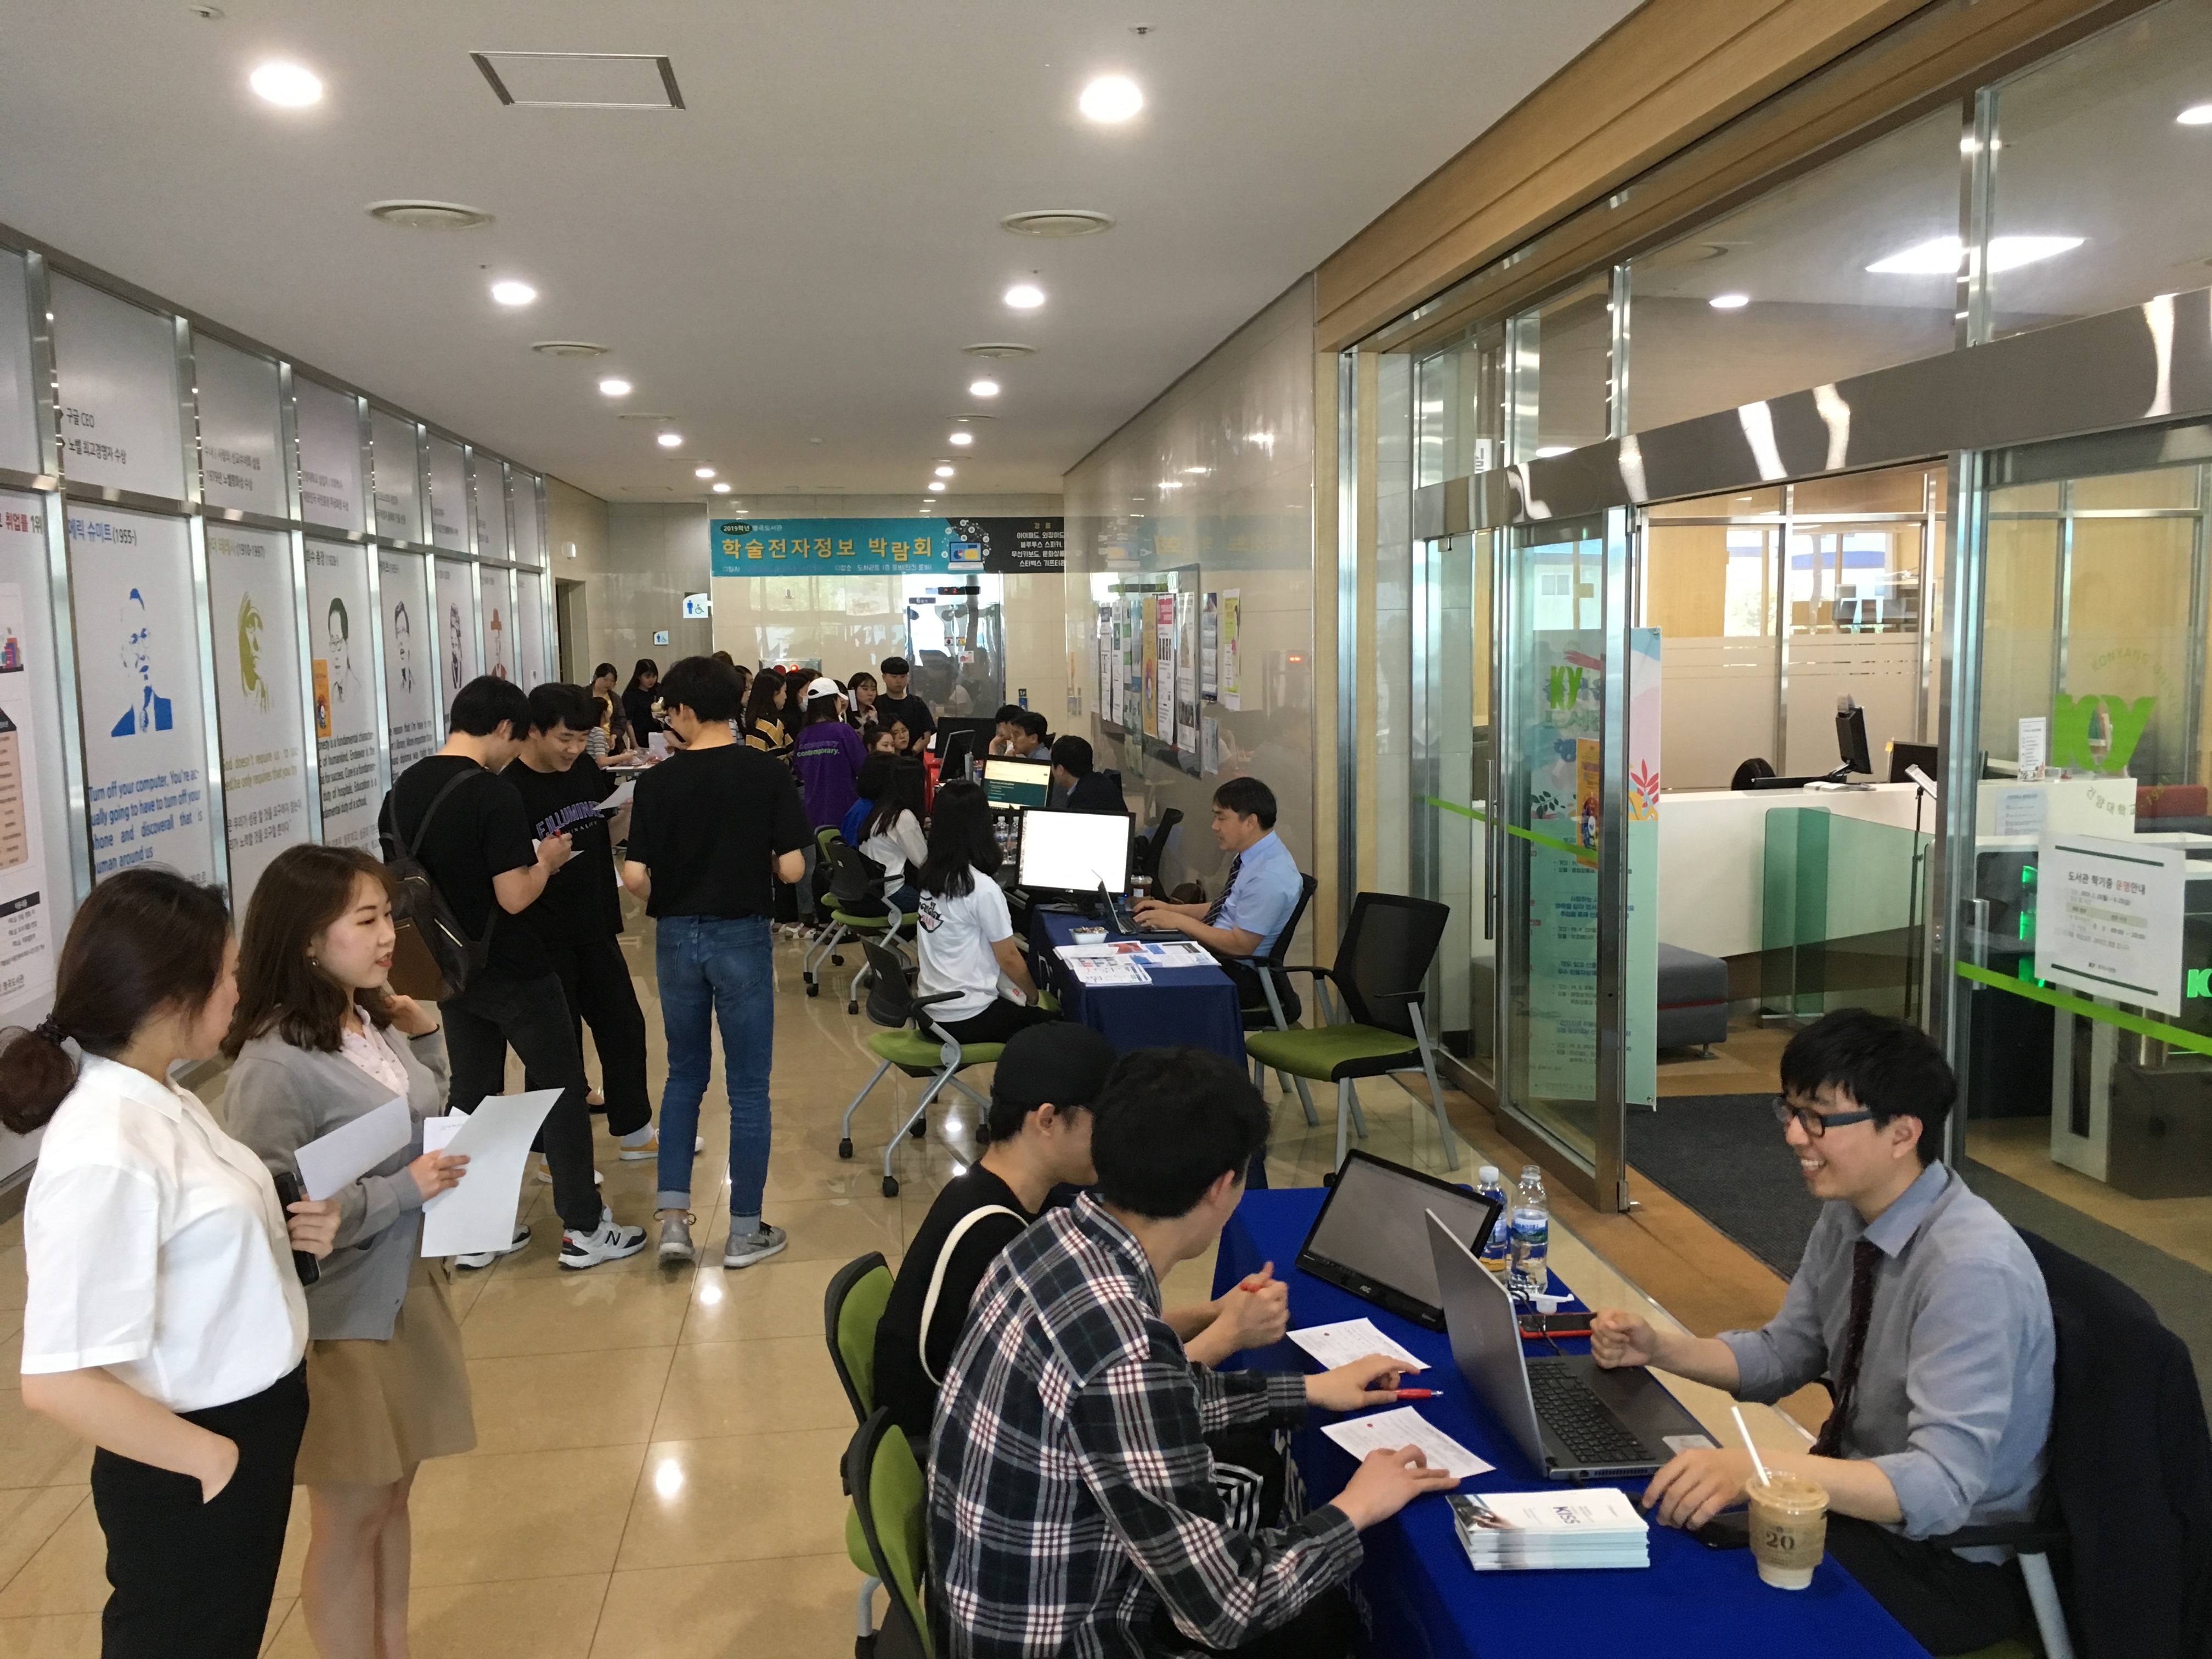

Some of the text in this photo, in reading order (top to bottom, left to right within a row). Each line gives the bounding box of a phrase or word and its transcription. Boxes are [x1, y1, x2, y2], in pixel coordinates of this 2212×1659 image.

[66, 408, 94, 428] 구글 CEO
[115, 448, 126, 465] 수상
[721, 538, 932, 561] 학술전자정보 박람회
[1550, 665, 1583, 710] KY
[2052, 693, 2157, 773] KY
[88, 786, 105, 802] Turn
[106, 780, 117, 799] off
[119, 782, 134, 799] your
[110, 804, 129, 825] going
[131, 803, 138, 817] to
[139, 799, 155, 814] have
[156, 797, 163, 810] to
[178, 788, 187, 805] off
[121, 824, 134, 843] and
[179, 811, 192, 827] that
[120, 845, 144, 867] around
[145, 847, 153, 859] us
[2068, 871, 2145, 895] 도서관 학기중 운영안내
[1553, 1506, 1581, 1525] KISS
